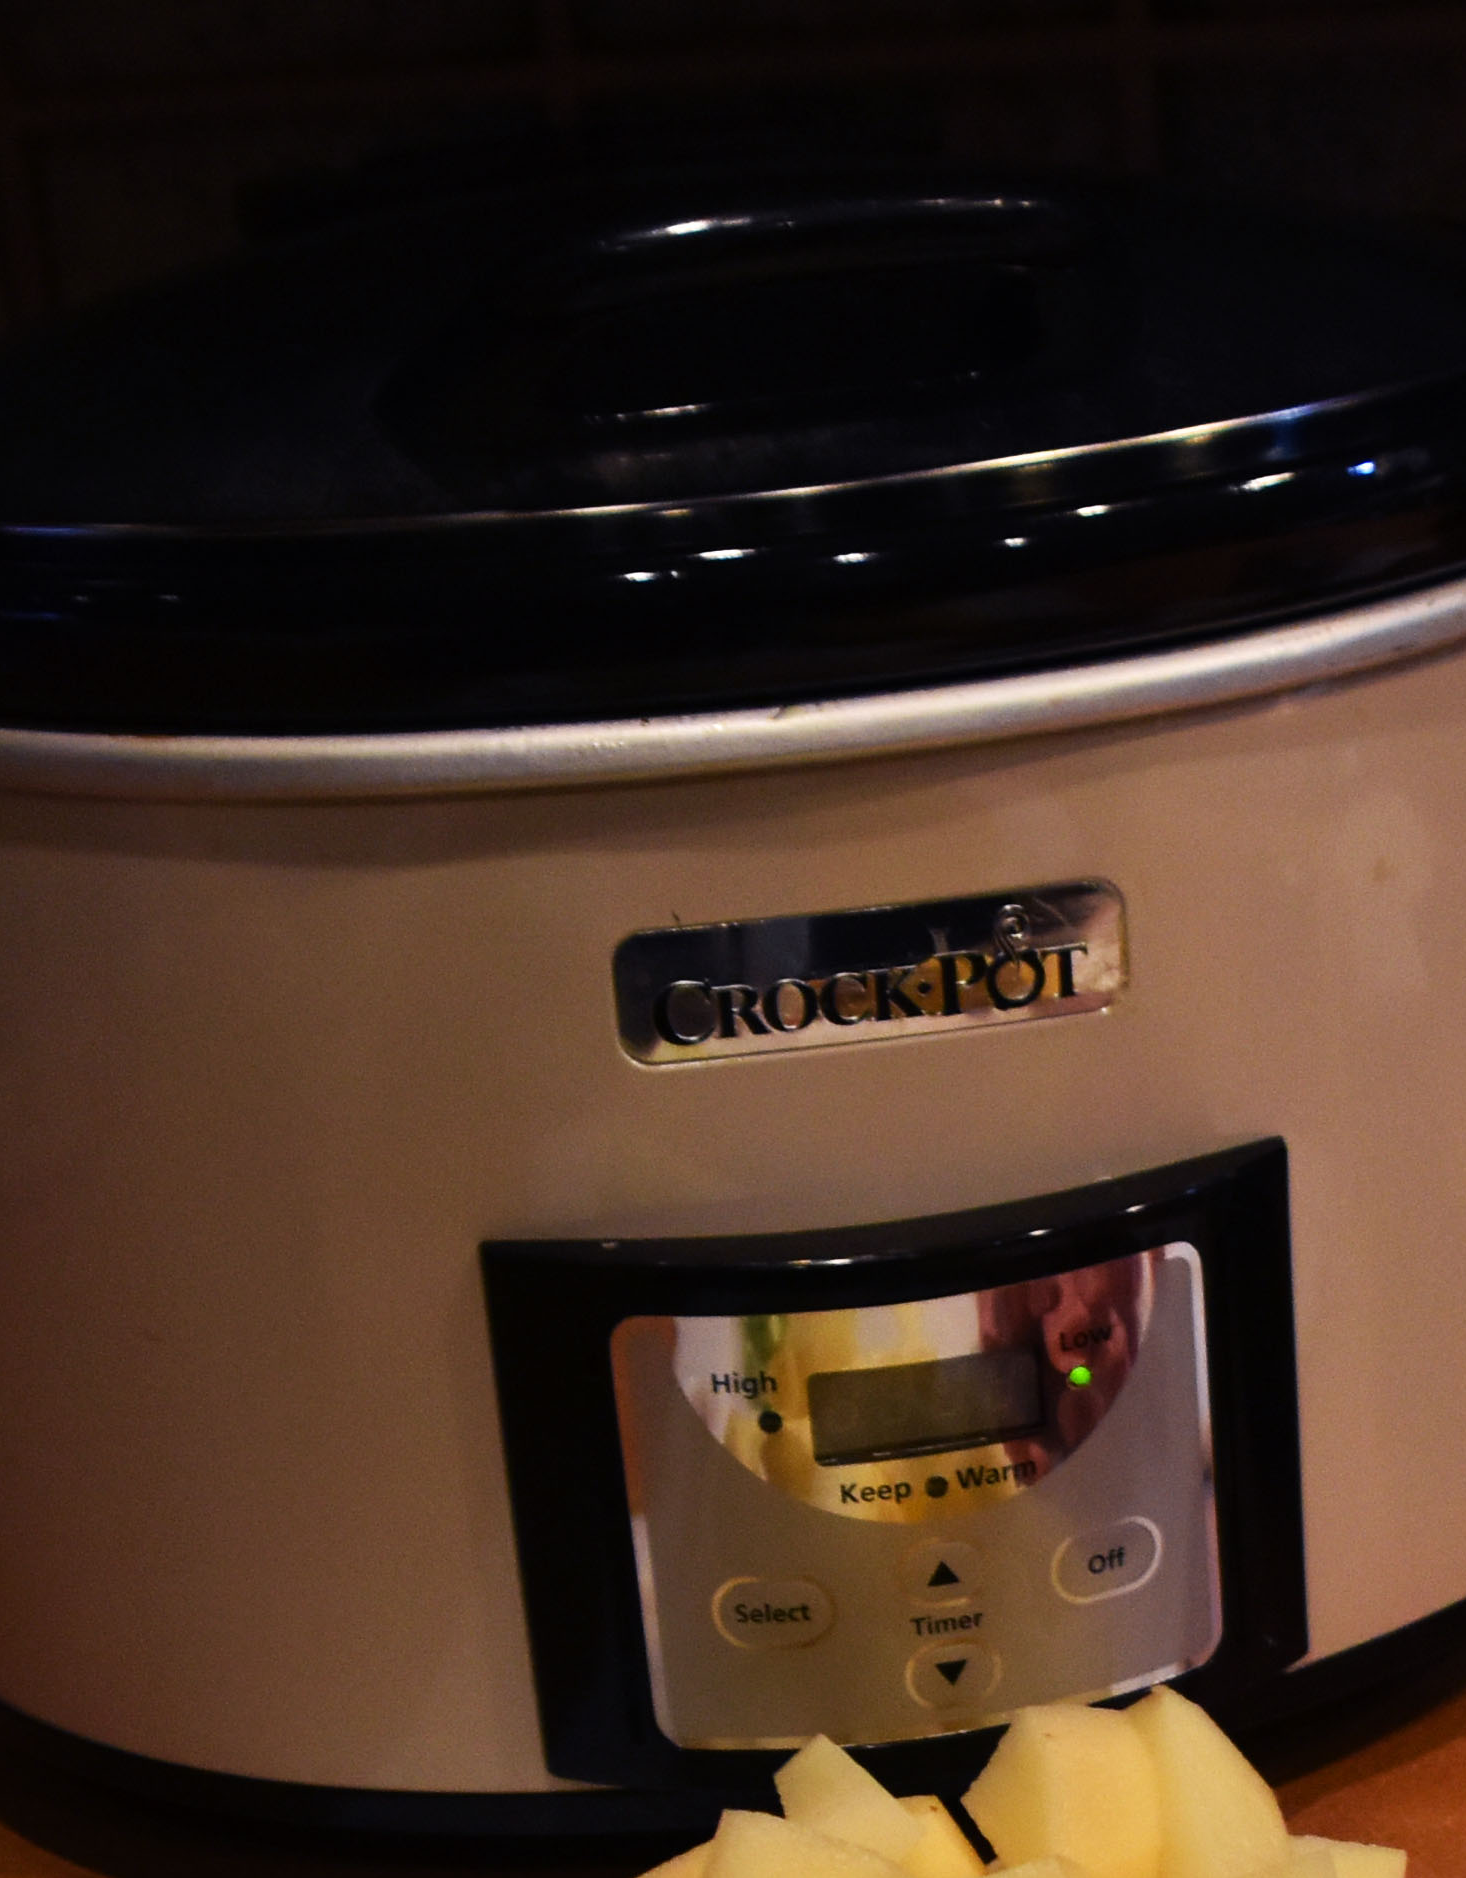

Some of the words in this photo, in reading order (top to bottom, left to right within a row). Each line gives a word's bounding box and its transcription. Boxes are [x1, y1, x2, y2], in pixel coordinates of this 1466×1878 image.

[1059, 1325, 1111, 1352] Low
[712, 1371, 779, 1399] High
[840, 1478, 912, 1505] Keep
[956, 1462, 1036, 1491] Warm
[1087, 1547, 1126, 1575] Off
[734, 1602, 811, 1625] Select
[910, 1610, 984, 1637] Timer
